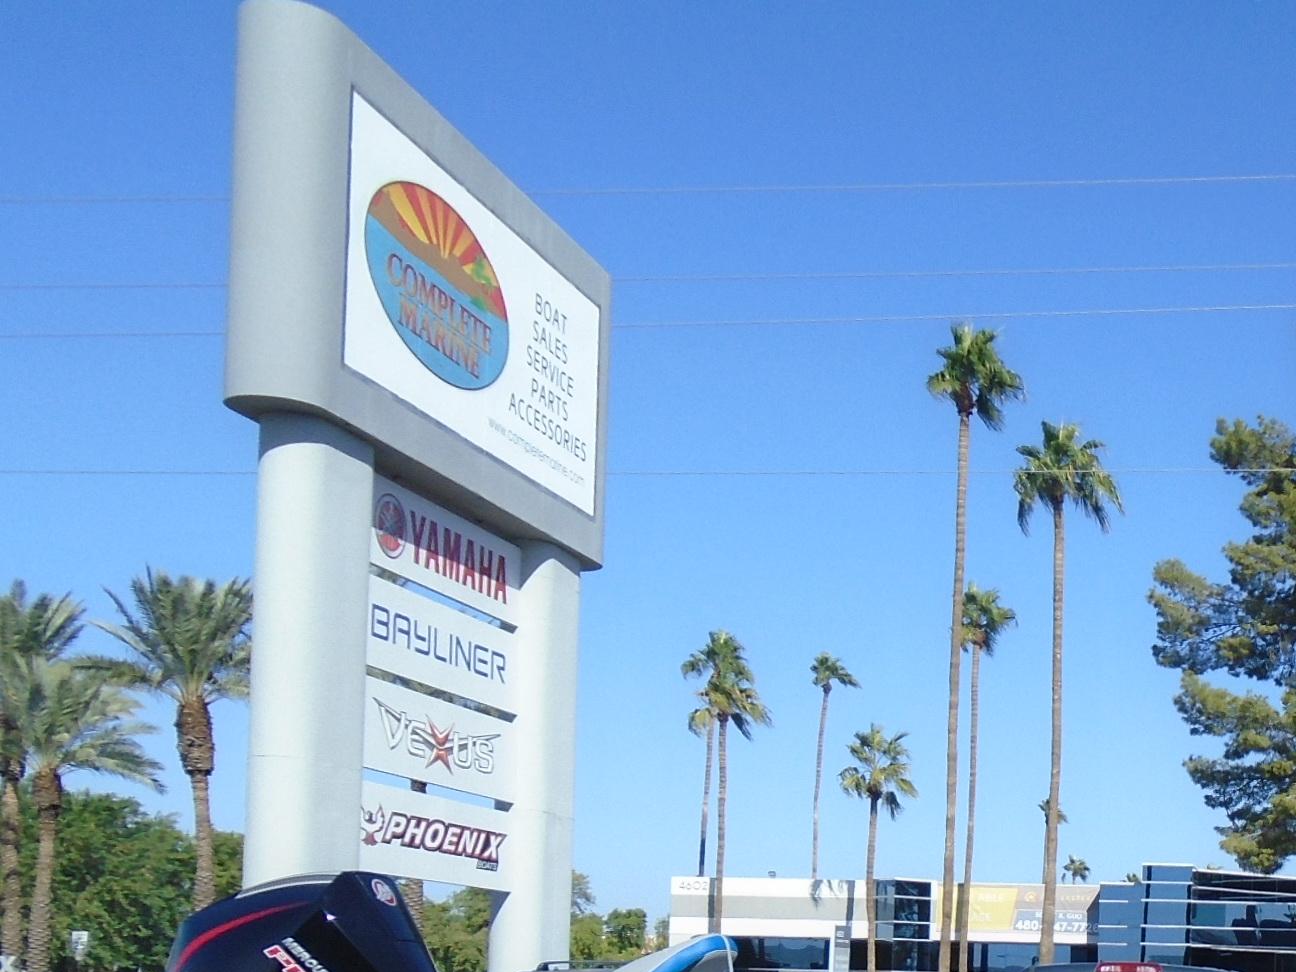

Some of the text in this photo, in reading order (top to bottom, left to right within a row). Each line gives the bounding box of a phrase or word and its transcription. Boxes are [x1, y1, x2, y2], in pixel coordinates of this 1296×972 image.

[387, 253, 492, 355] COMPLETE
[534, 292, 568, 334] BOAT
[398, 301, 480, 379] MARINE
[526, 345, 574, 398] SERVICE
[532, 320, 568, 365] SALES
[508, 392, 586, 463] ACCESSORIES
[531, 378, 569, 422] PARTS
[409, 510, 508, 605] YAMAHA
[370, 603, 507, 684] BAYLINER
[372, 696, 502, 776] VEXUS
[382, 811, 508, 864] PHOENIX
